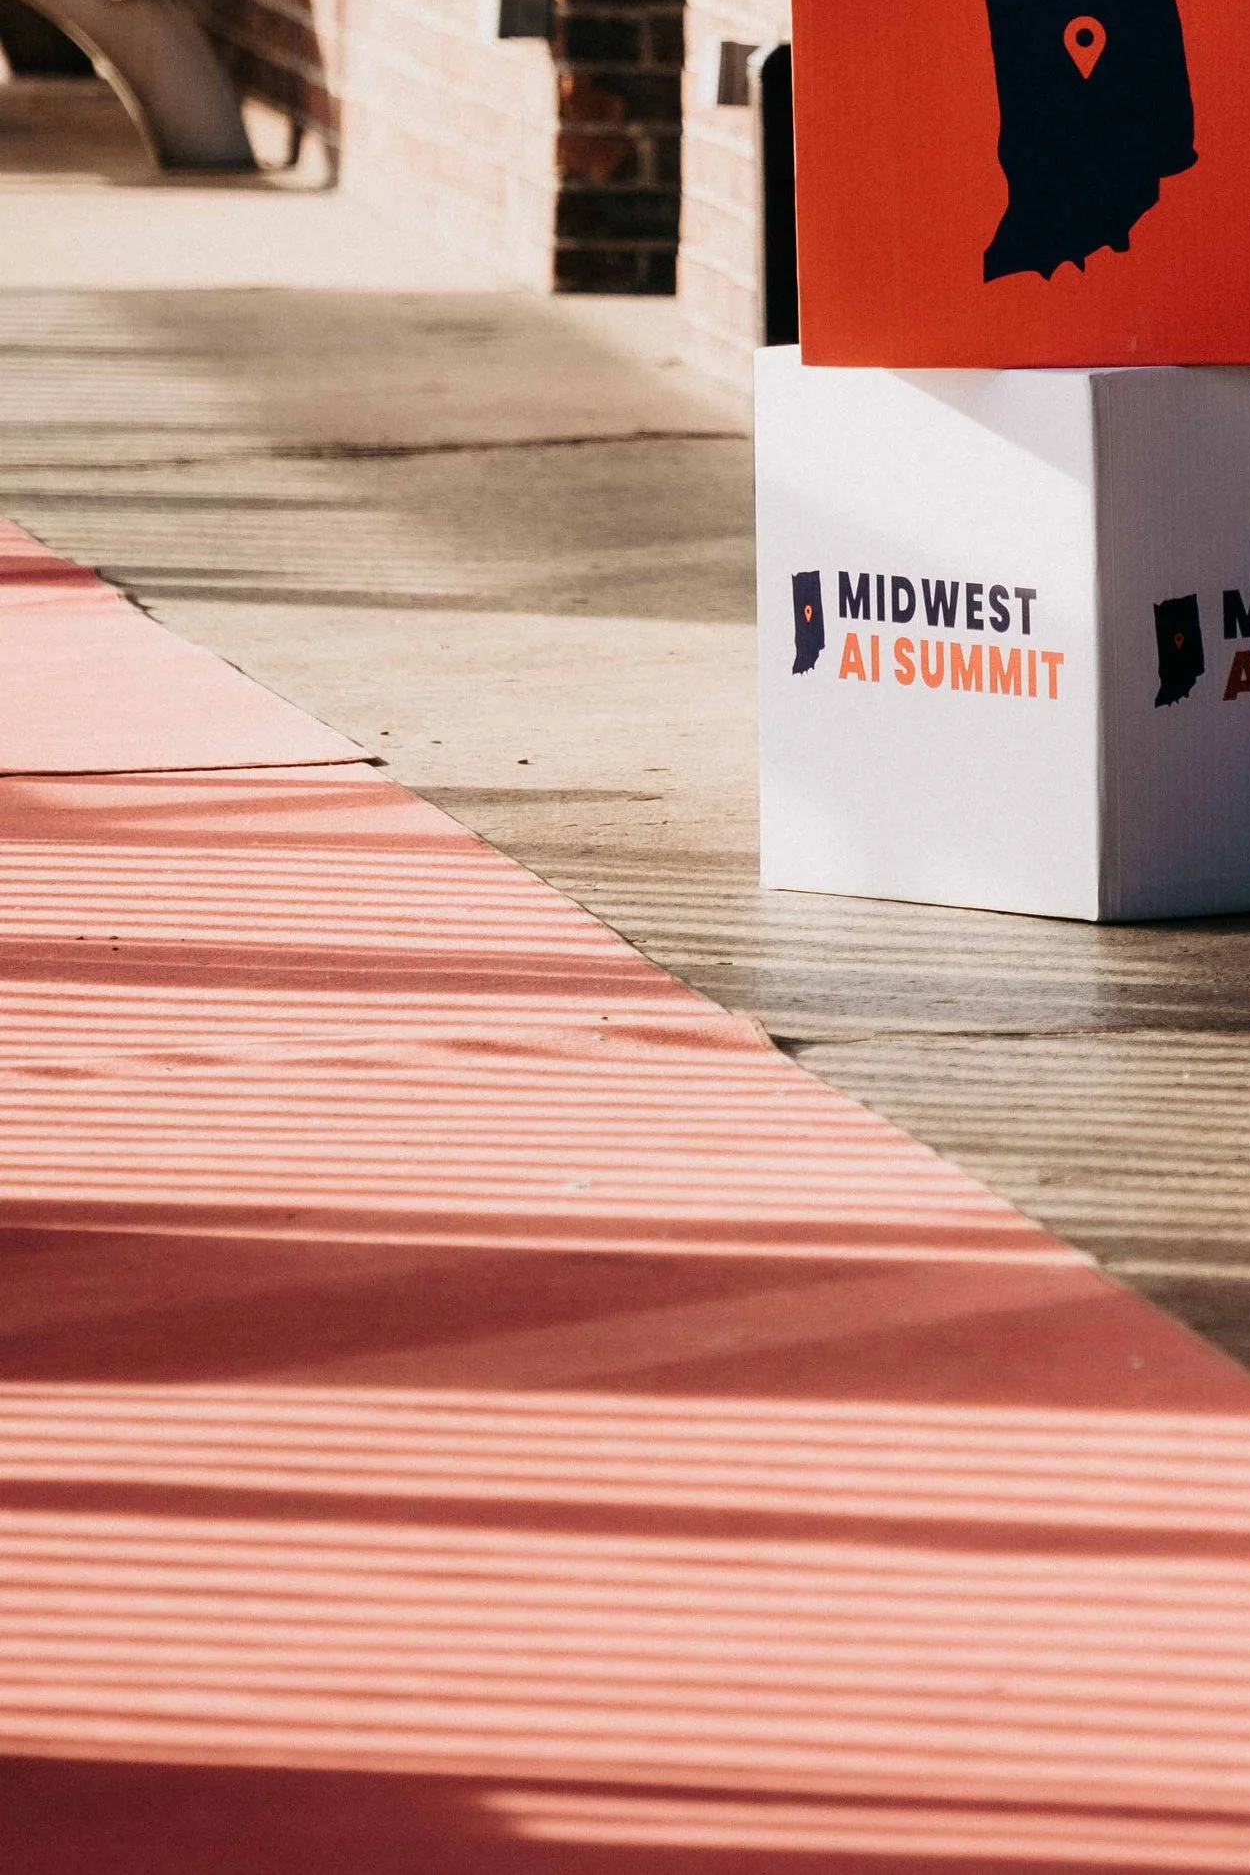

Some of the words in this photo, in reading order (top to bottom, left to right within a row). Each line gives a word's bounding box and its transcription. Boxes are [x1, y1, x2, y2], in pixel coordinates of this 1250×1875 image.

[838, 571, 1037, 635] MIDWEST
[838, 633, 880, 682] AI
[894, 637, 1064, 700] SUMMIT
